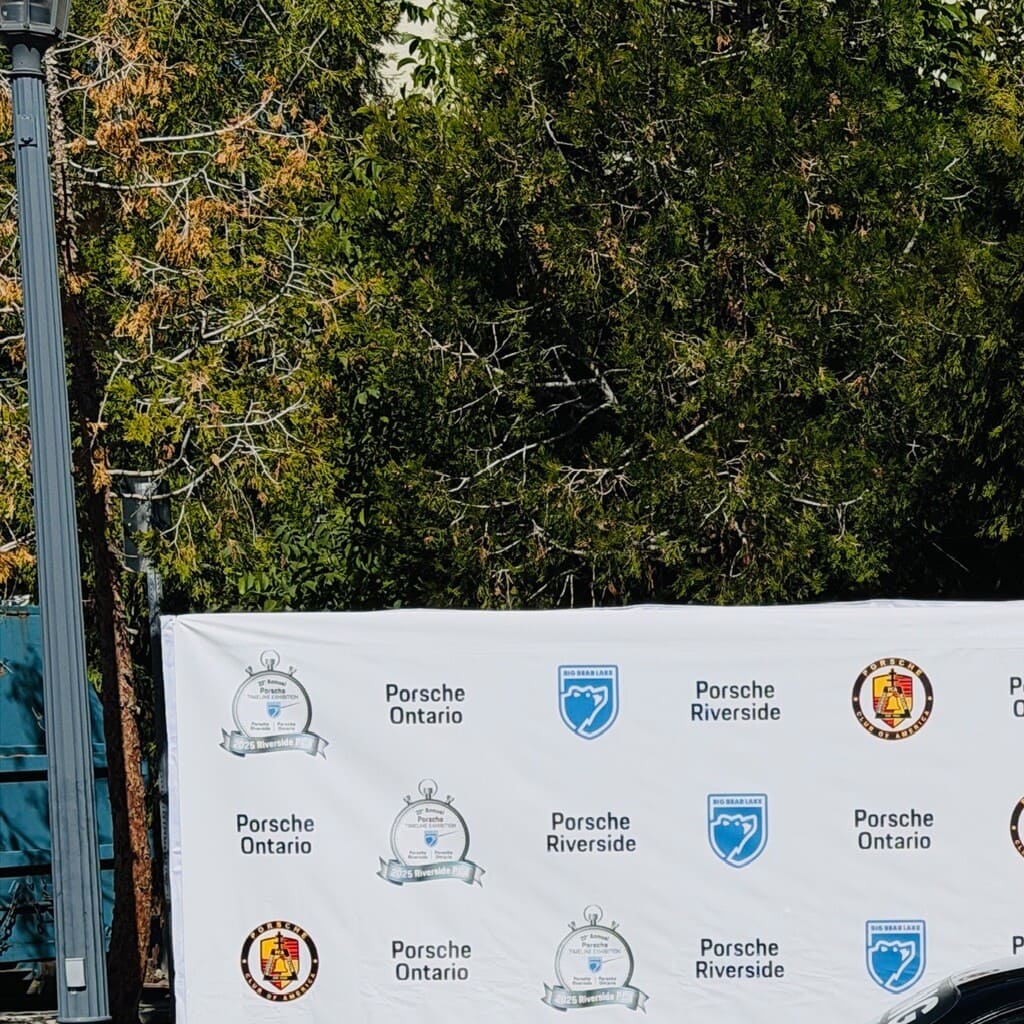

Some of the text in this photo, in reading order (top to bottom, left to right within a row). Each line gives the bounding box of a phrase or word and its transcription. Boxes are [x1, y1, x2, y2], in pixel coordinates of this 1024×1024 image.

[862, 659, 922, 676] PORSCHE
[259, 687, 286, 695] Porsche
[386, 684, 464, 702] Porsche
[697, 680, 774, 699] Porsche
[390, 707, 462, 724] Ontario
[692, 703, 780, 720] Riverside
[856, 710, 930, 739] CLUB OF AMERICA
[256, 738, 294, 749] Riverside
[237, 814, 314, 832] Porsche
[417, 816, 444, 824] Porsche
[552, 812, 630, 830] Porsche
[855, 809, 933, 827] Porsche
[241, 837, 311, 854] Ontario
[547, 835, 635, 852] Riverside
[859, 832, 930, 849] Ontario
[414, 866, 452, 877] Riverside
[250, 922, 307, 939] PORSCHE
[392, 941, 471, 958] Porsche
[581, 941, 608, 949] Porsche
[701, 938, 778, 956] Porsche
[396, 963, 468, 980] Ontario
[696, 961, 784, 978] Riverside
[245, 972, 316, 1001] CLUB OF AMERICA
[578, 992, 615, 1004] Riverside
